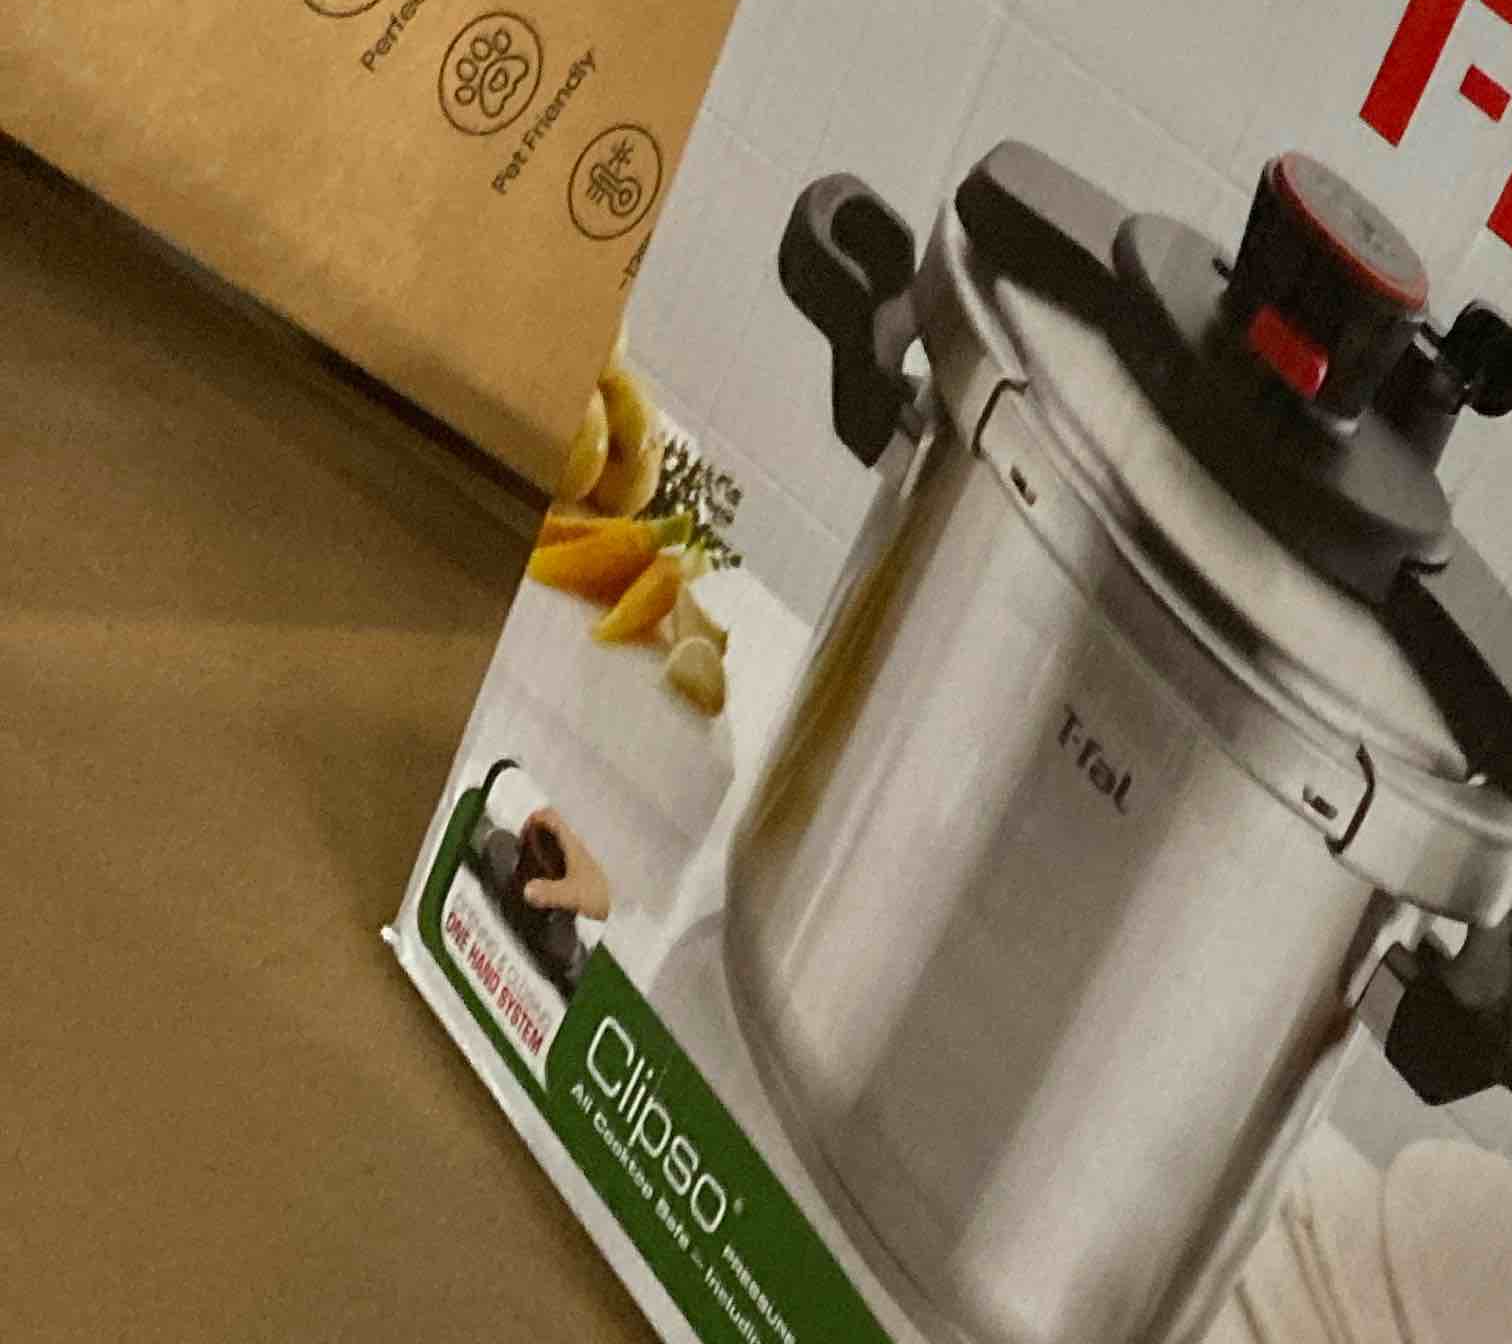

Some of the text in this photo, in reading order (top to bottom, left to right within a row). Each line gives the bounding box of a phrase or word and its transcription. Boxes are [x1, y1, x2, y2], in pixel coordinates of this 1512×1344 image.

[491, 49, 598, 196] Pet Friendly
[1058, 704, 1132, 815] T-fal
[446, 912, 545, 1056] ONE HAND SYSTEM
[572, 1082, 593, 1115] All
[590, 1112, 654, 1202] Cooktop
[655, 1197, 689, 1250] Safe
[585, 1014, 728, 1233] Clipso
